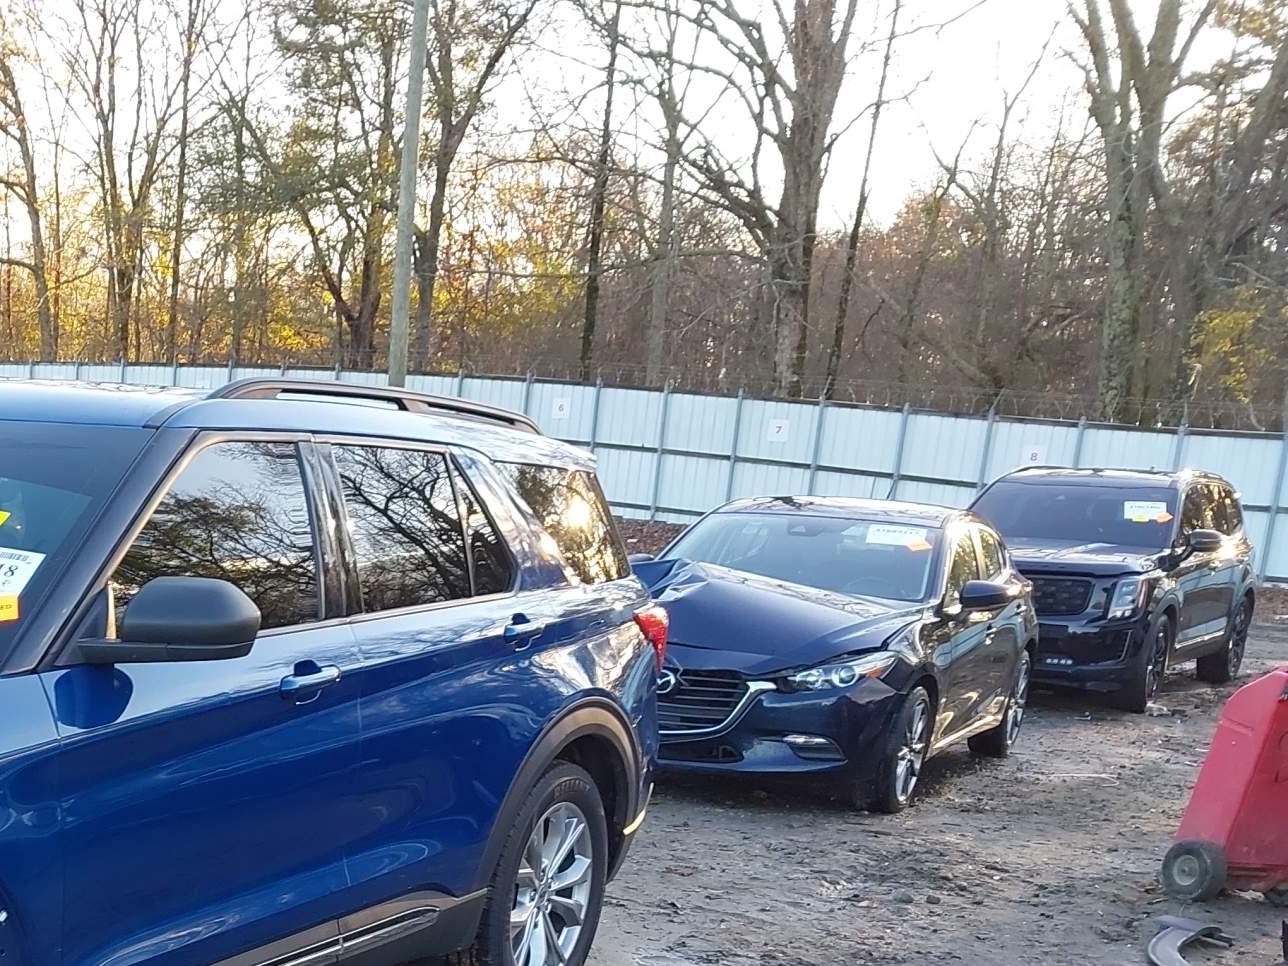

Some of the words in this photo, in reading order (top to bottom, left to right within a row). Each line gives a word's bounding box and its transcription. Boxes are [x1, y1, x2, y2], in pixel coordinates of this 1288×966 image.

[558, 403, 565, 412] 6
[775, 425, 783, 434] 7
[1030, 452, 1038, 461] 8
